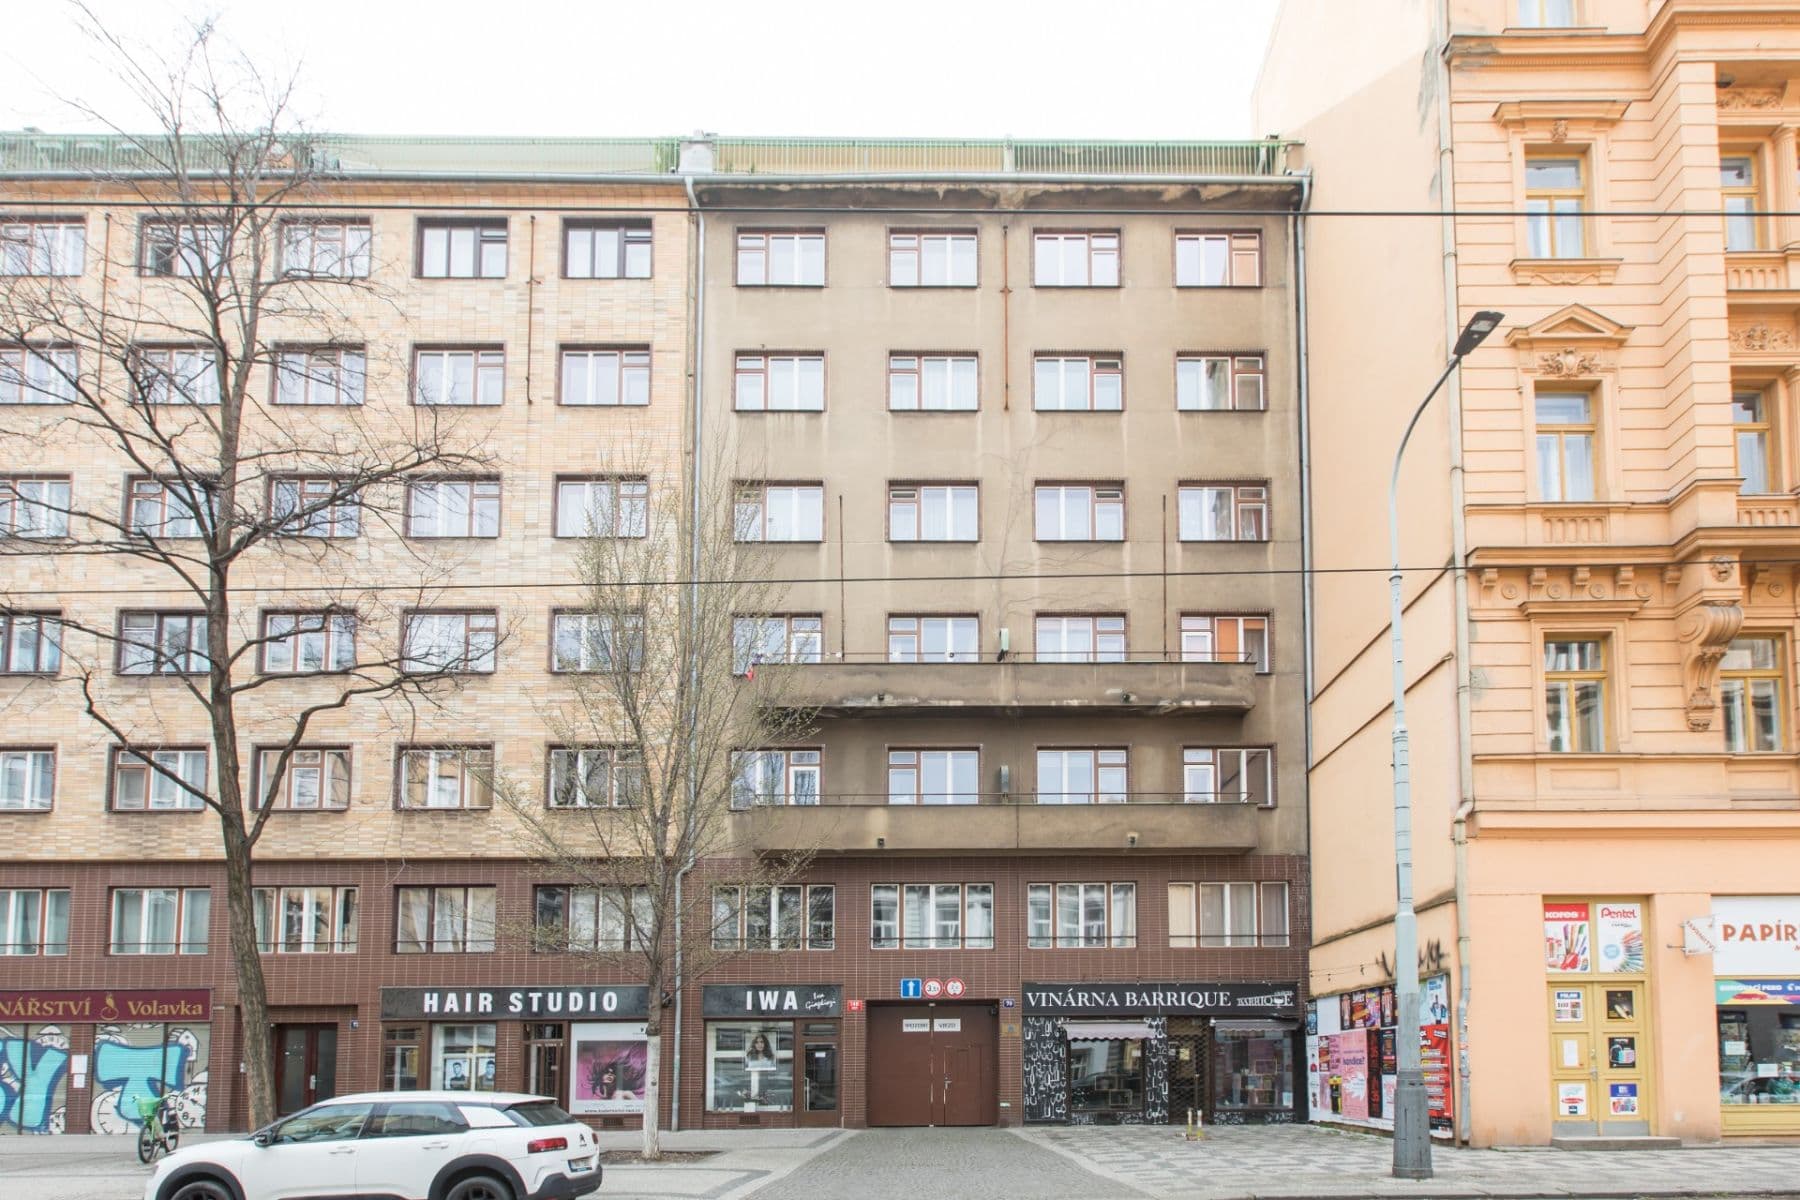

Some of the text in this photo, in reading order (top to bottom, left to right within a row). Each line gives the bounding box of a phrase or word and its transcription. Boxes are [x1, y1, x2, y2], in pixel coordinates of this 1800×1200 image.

[1601, 908, 1637, 919] Pentel
[128, 1000, 203, 1016] Volavka
[423, 991, 618, 1013] HAIR STUDIO
[746, 990, 798, 1011] IWA
[1026, 988, 1231, 1009] VINÁRNA BARRIQUE
